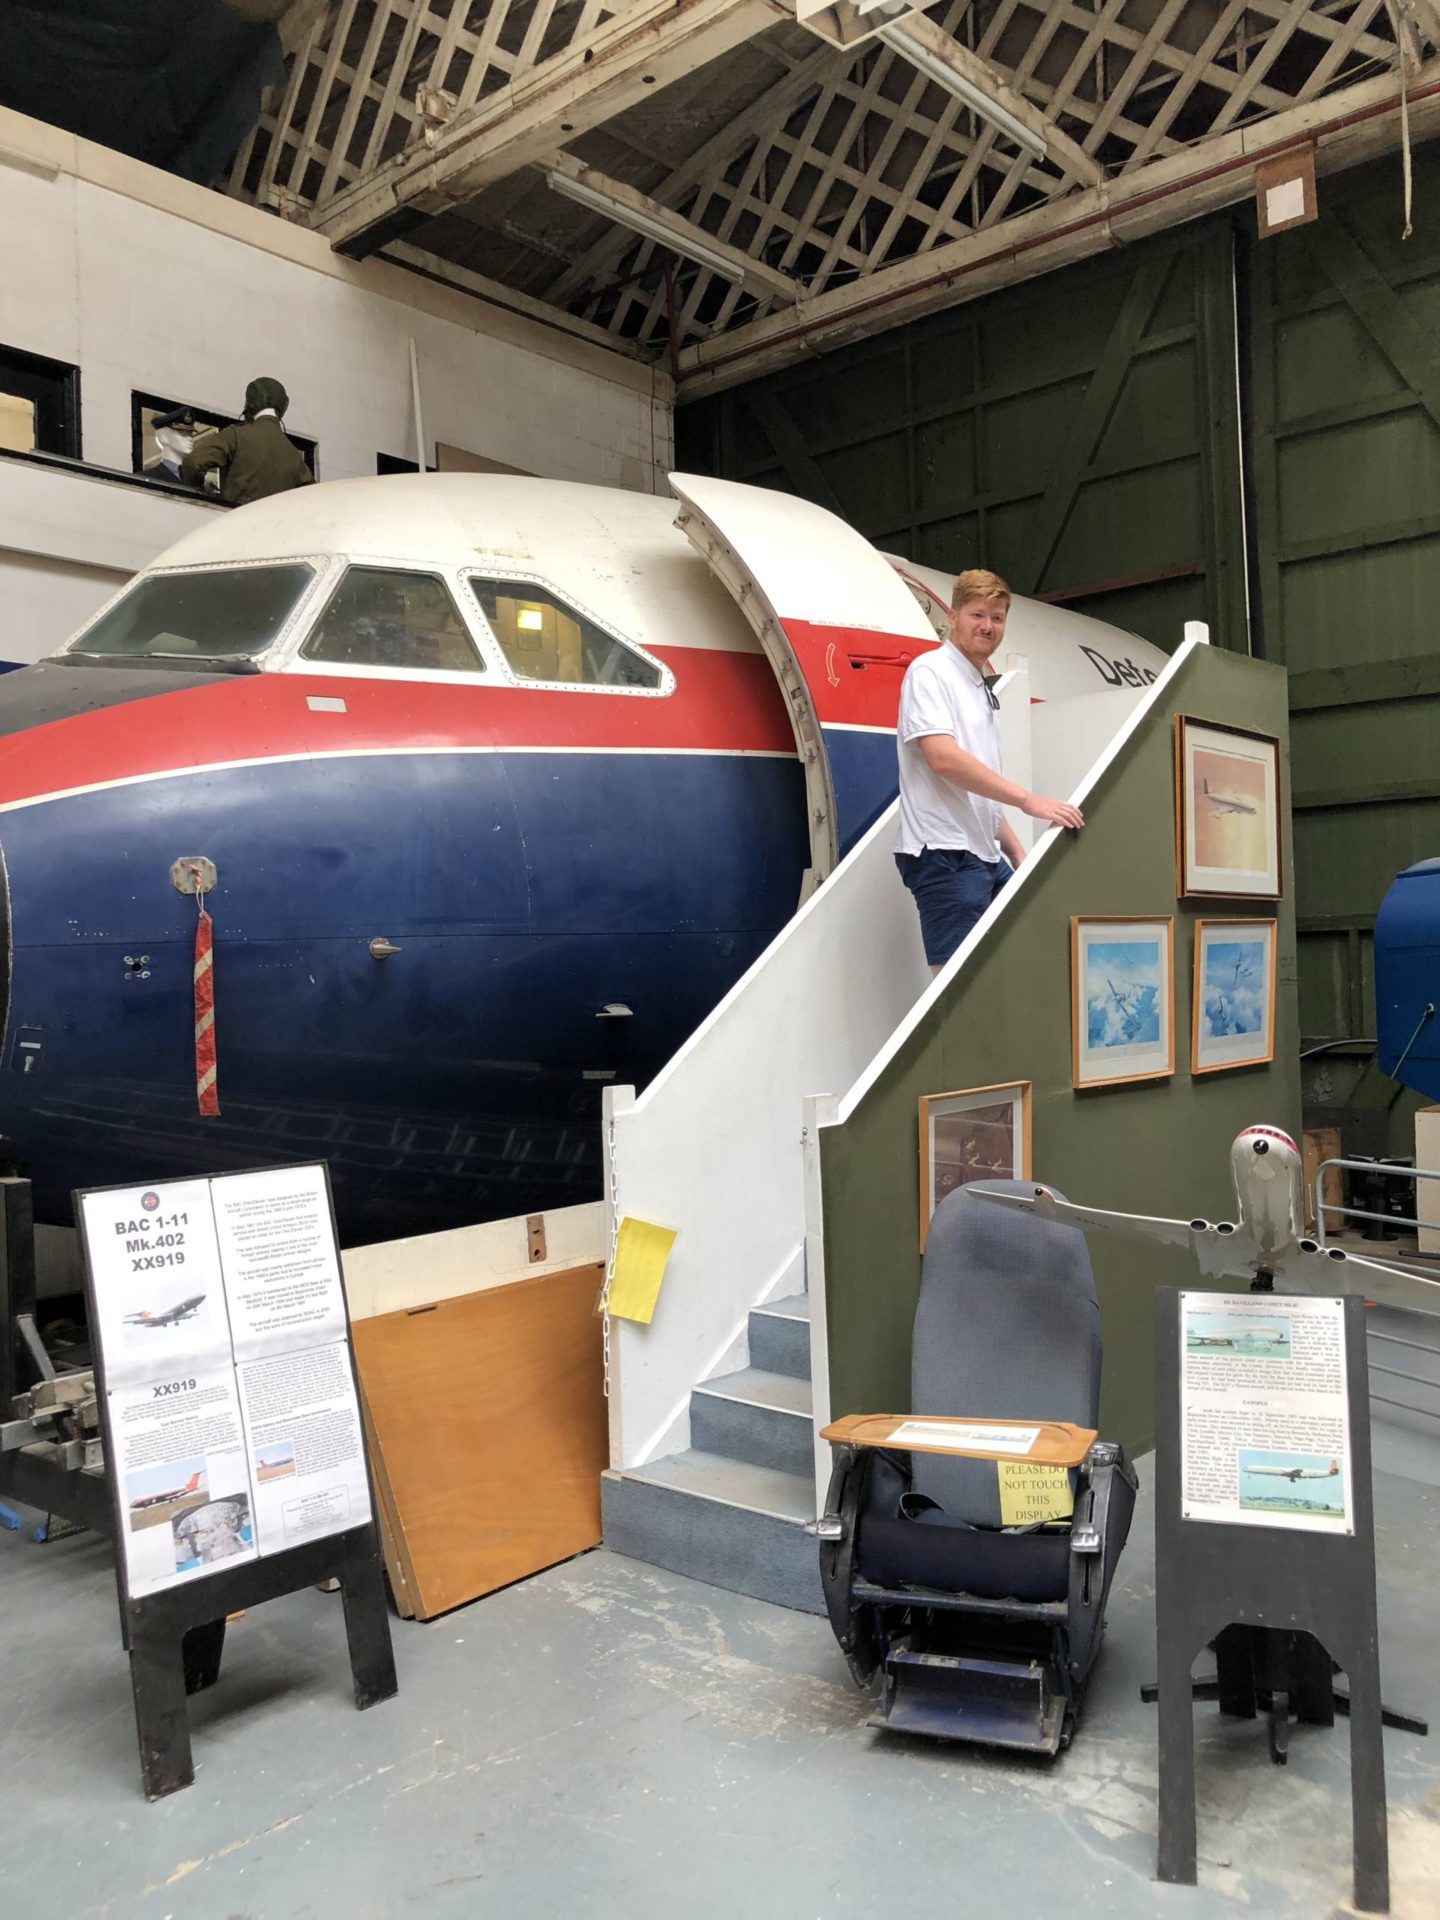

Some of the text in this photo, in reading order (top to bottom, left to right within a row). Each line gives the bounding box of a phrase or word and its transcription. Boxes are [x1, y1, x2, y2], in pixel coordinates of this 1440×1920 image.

[115, 1212, 189, 1235] BAC 1-11
[125, 1232, 186, 1253] Mk.402
[131, 1251, 186, 1272] XX919
[153, 1378, 197, 1398] XX919
[1006, 1466, 1064, 1475] PLEASE DO
[1005, 1480, 1068, 1490] NOT TOUCH
[1026, 1496, 1050, 1504] THIS
[1016, 1511, 1061, 1520] DISPLAY
